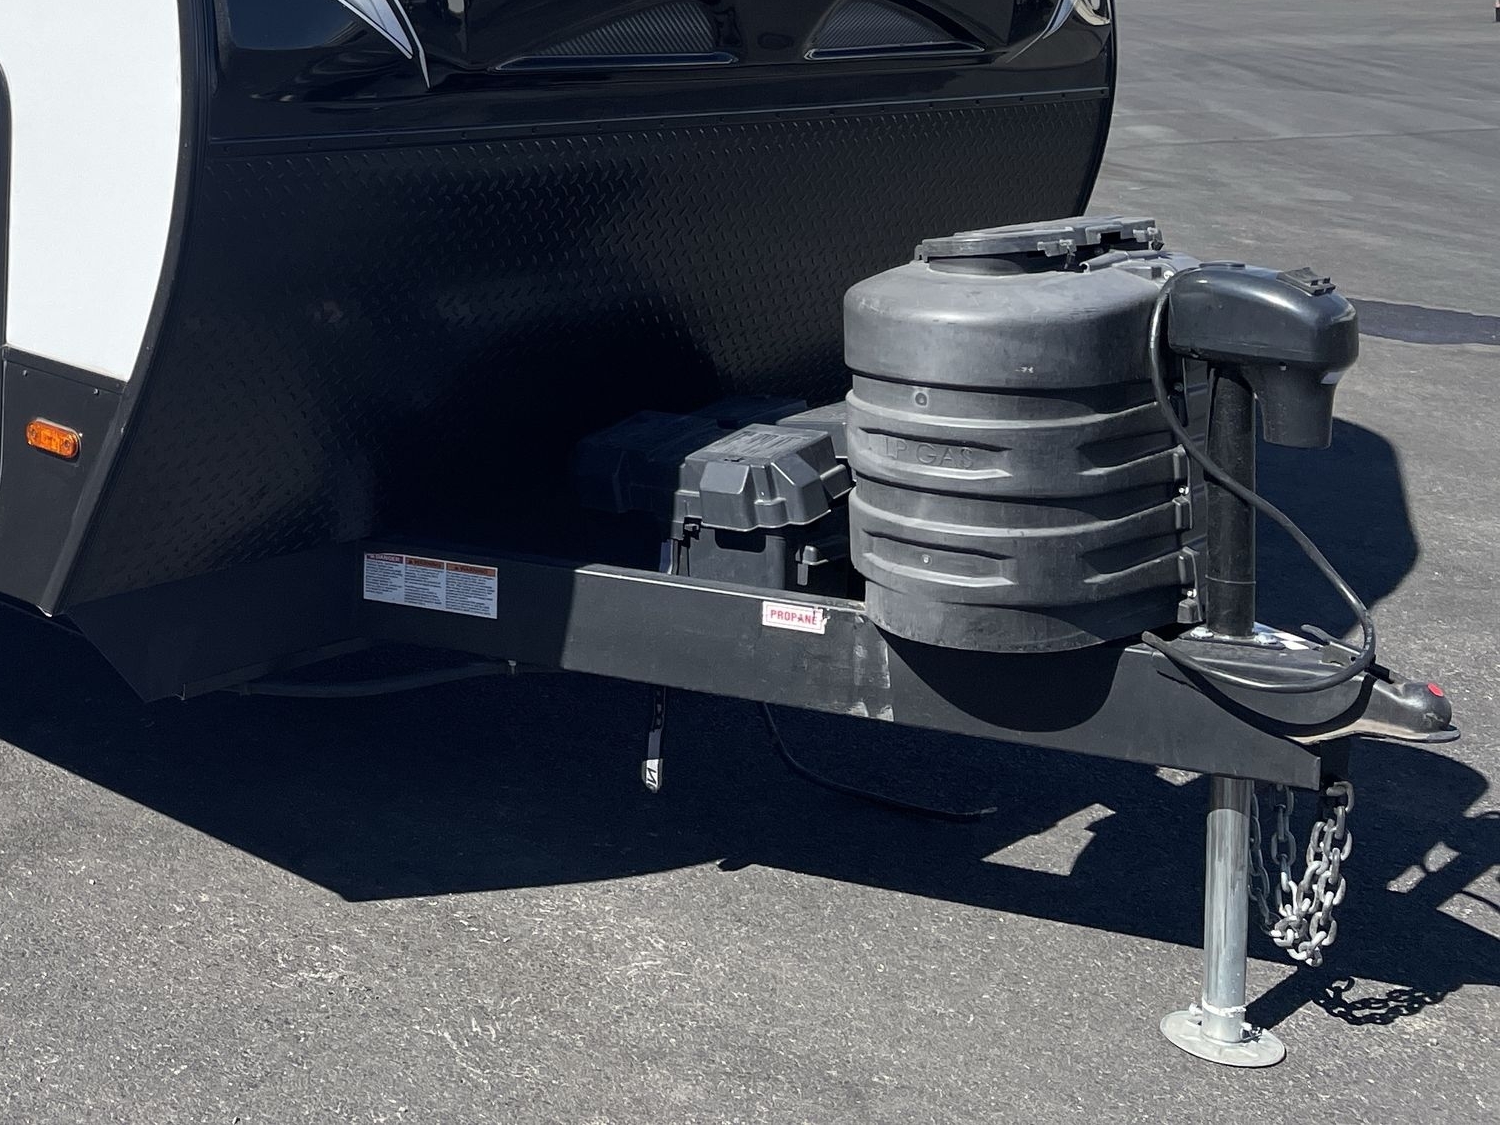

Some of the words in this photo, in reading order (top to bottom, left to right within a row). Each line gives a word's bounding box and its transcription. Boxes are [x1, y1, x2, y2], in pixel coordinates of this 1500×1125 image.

[883, 436, 908, 461] LP
[915, 442, 974, 469] GAS
[769, 609, 818, 626] PROPANE
